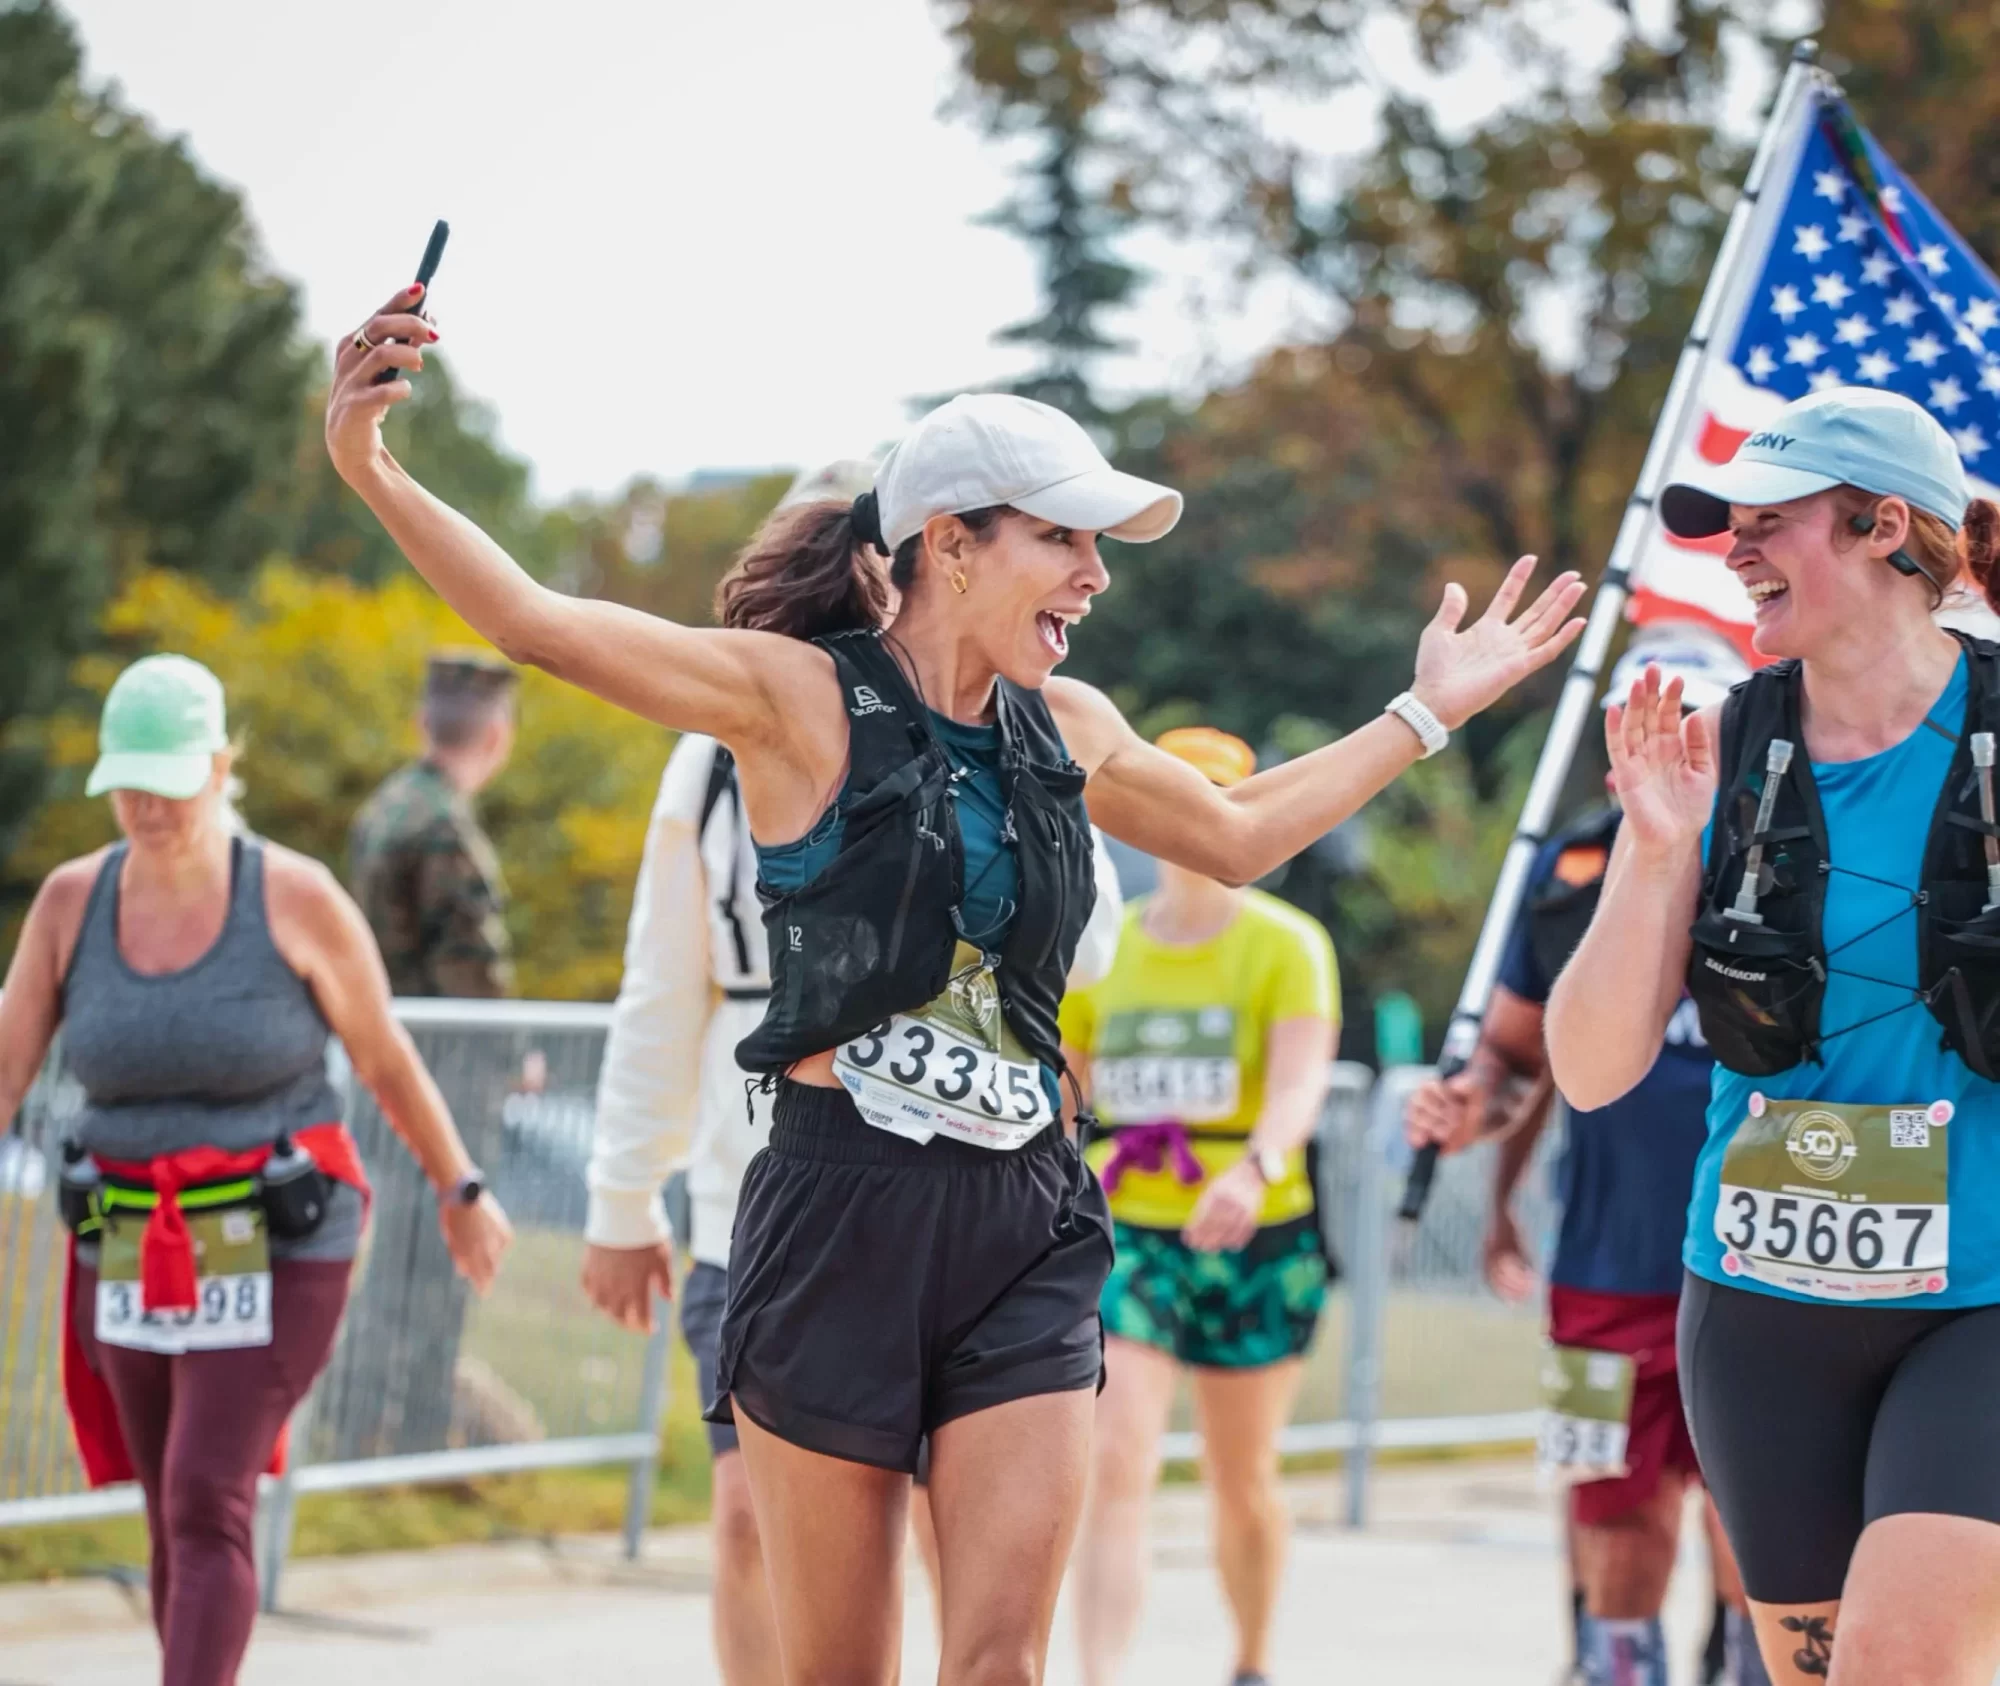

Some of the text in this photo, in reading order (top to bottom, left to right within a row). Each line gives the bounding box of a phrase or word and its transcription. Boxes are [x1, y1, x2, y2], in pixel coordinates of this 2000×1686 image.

[788, 925, 802, 946] 12
[1705, 957, 1766, 981] SALOMON
[901, 1104, 931, 1120] KPMG
[1724, 1191, 1932, 1269] 35667
[109, 1277, 256, 1326] 398
